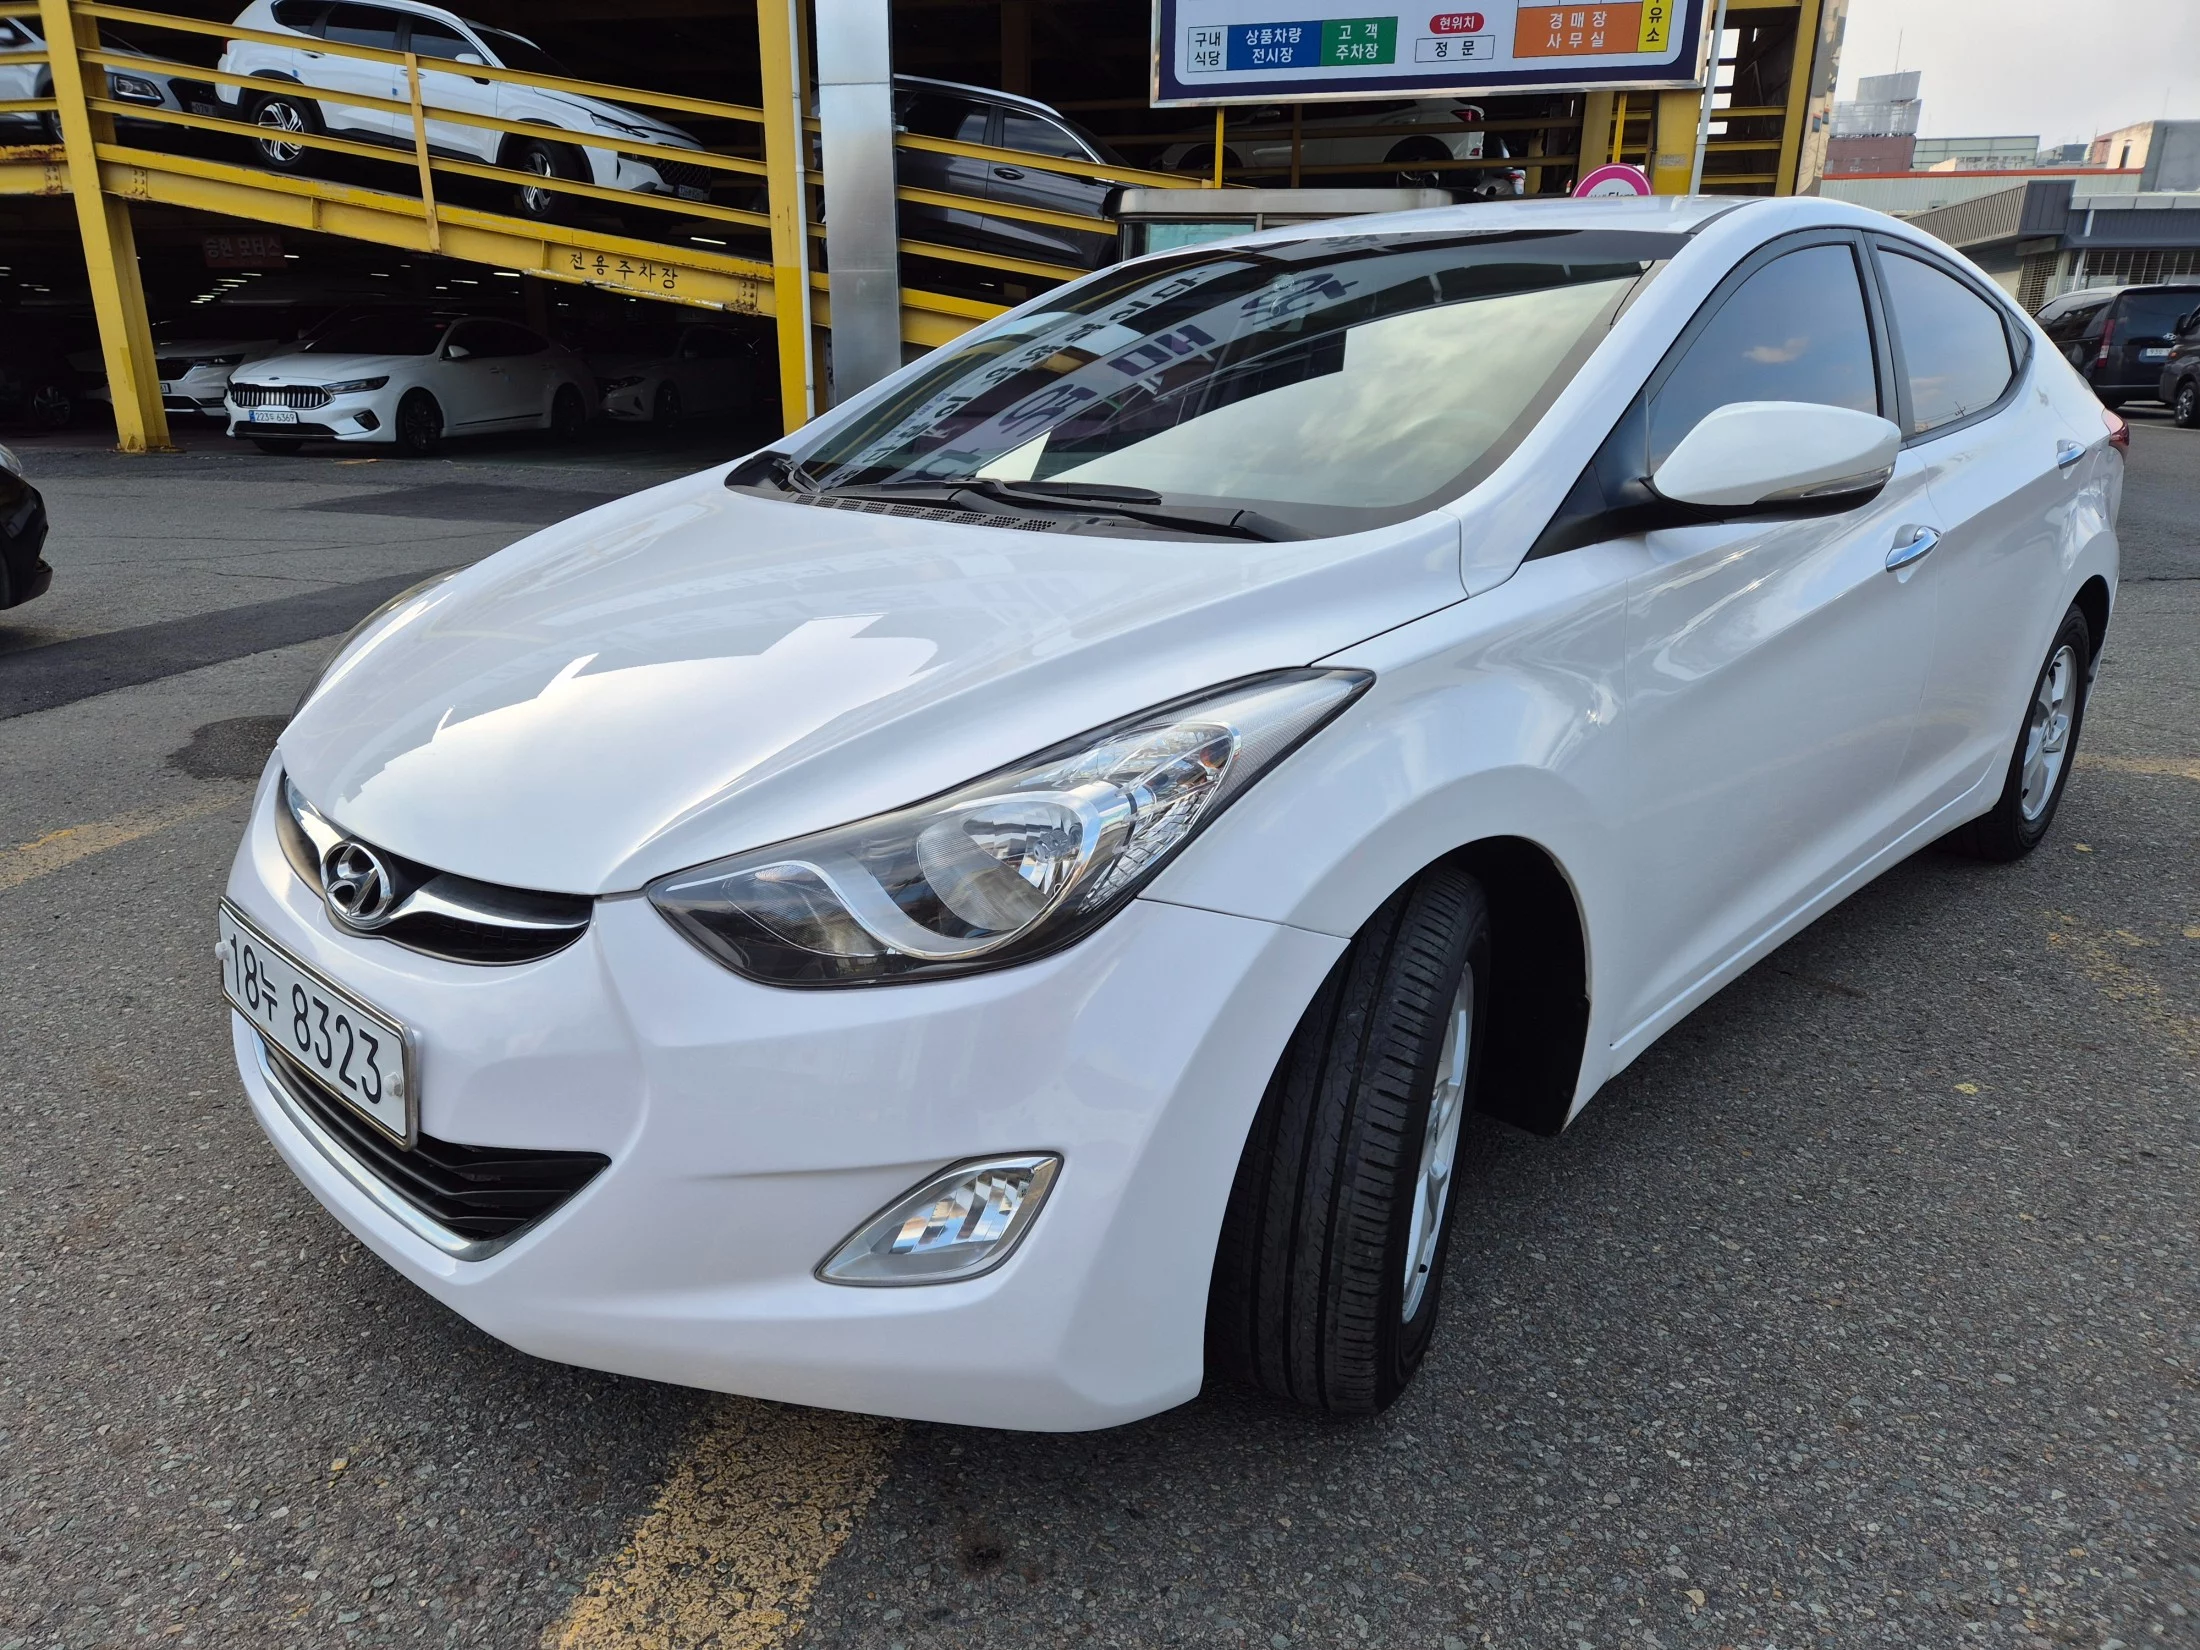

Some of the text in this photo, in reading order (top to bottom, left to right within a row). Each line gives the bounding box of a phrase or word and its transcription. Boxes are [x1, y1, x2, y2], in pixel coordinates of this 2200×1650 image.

[1439, 16, 1475, 30] 현위치
[1549, 11, 1607, 29] 경매장
[1646, 0, 1662, 42] 유소
[1195, 32, 1221, 47] 구내
[1245, 27, 1302, 45] 상품차량
[1338, 23, 1378, 40] 고객
[1546, 31, 1605, 49] 사무실
[1252, 47, 1293, 64] 전시장
[1336, 43, 1379, 60] 주차장
[1434, 41, 1475, 57] 정문
[1194, 51, 1220, 66] 식당
[238, 236, 281, 258] 모터스
[569, 251, 679, 289] 전용주차장
[276, 413, 295, 422] 6369
[230, 933, 383, 1105] 18누 8323
